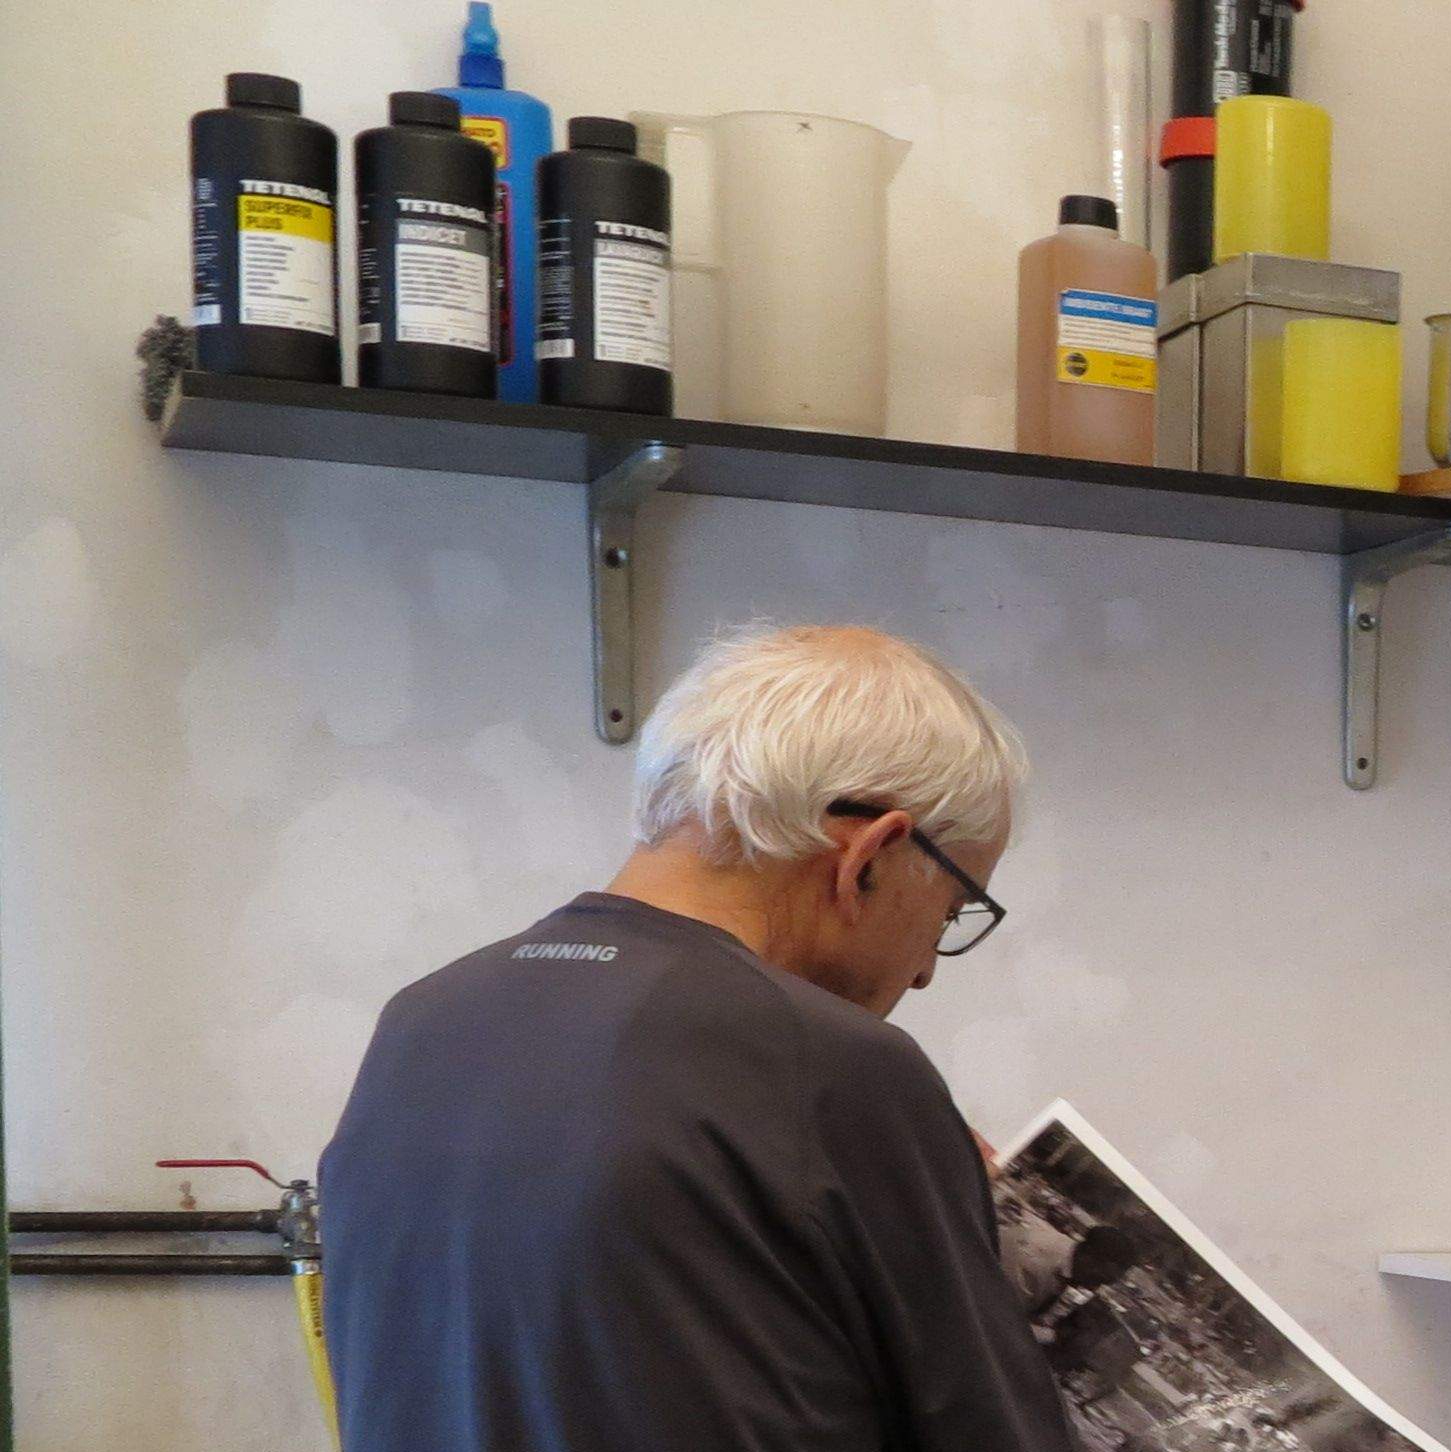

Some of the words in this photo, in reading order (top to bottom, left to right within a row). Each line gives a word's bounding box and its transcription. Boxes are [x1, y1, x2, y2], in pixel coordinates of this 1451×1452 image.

[239, 179, 333, 205] TETENAL
[395, 198, 489, 223] TETENAL
[510, 942, 619, 962] RUNNING
